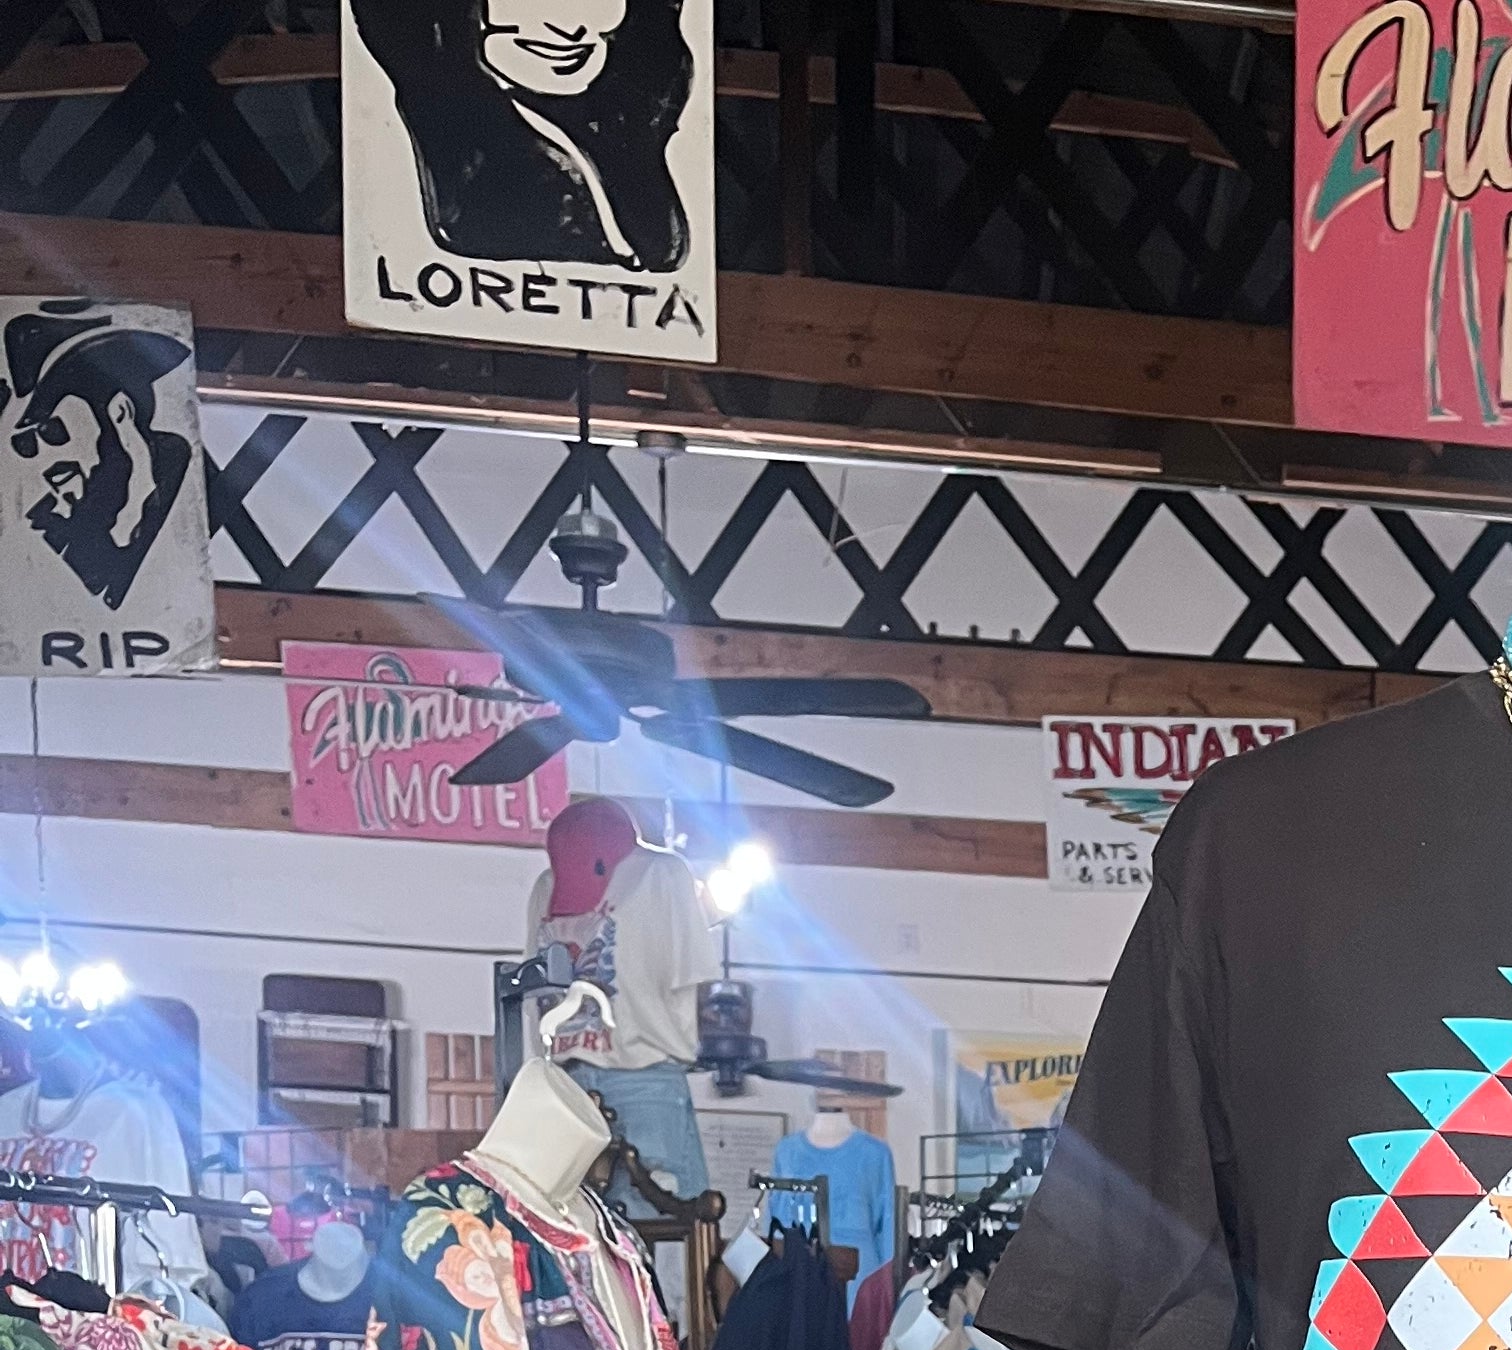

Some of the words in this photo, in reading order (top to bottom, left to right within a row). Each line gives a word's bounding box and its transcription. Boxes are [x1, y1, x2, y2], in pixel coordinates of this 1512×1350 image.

[376, 254, 705, 338] LORETTA
[41, 630, 170, 669] RIP
[1061, 840, 1138, 862] PARTS
[1078, 866, 1094, 885] &
